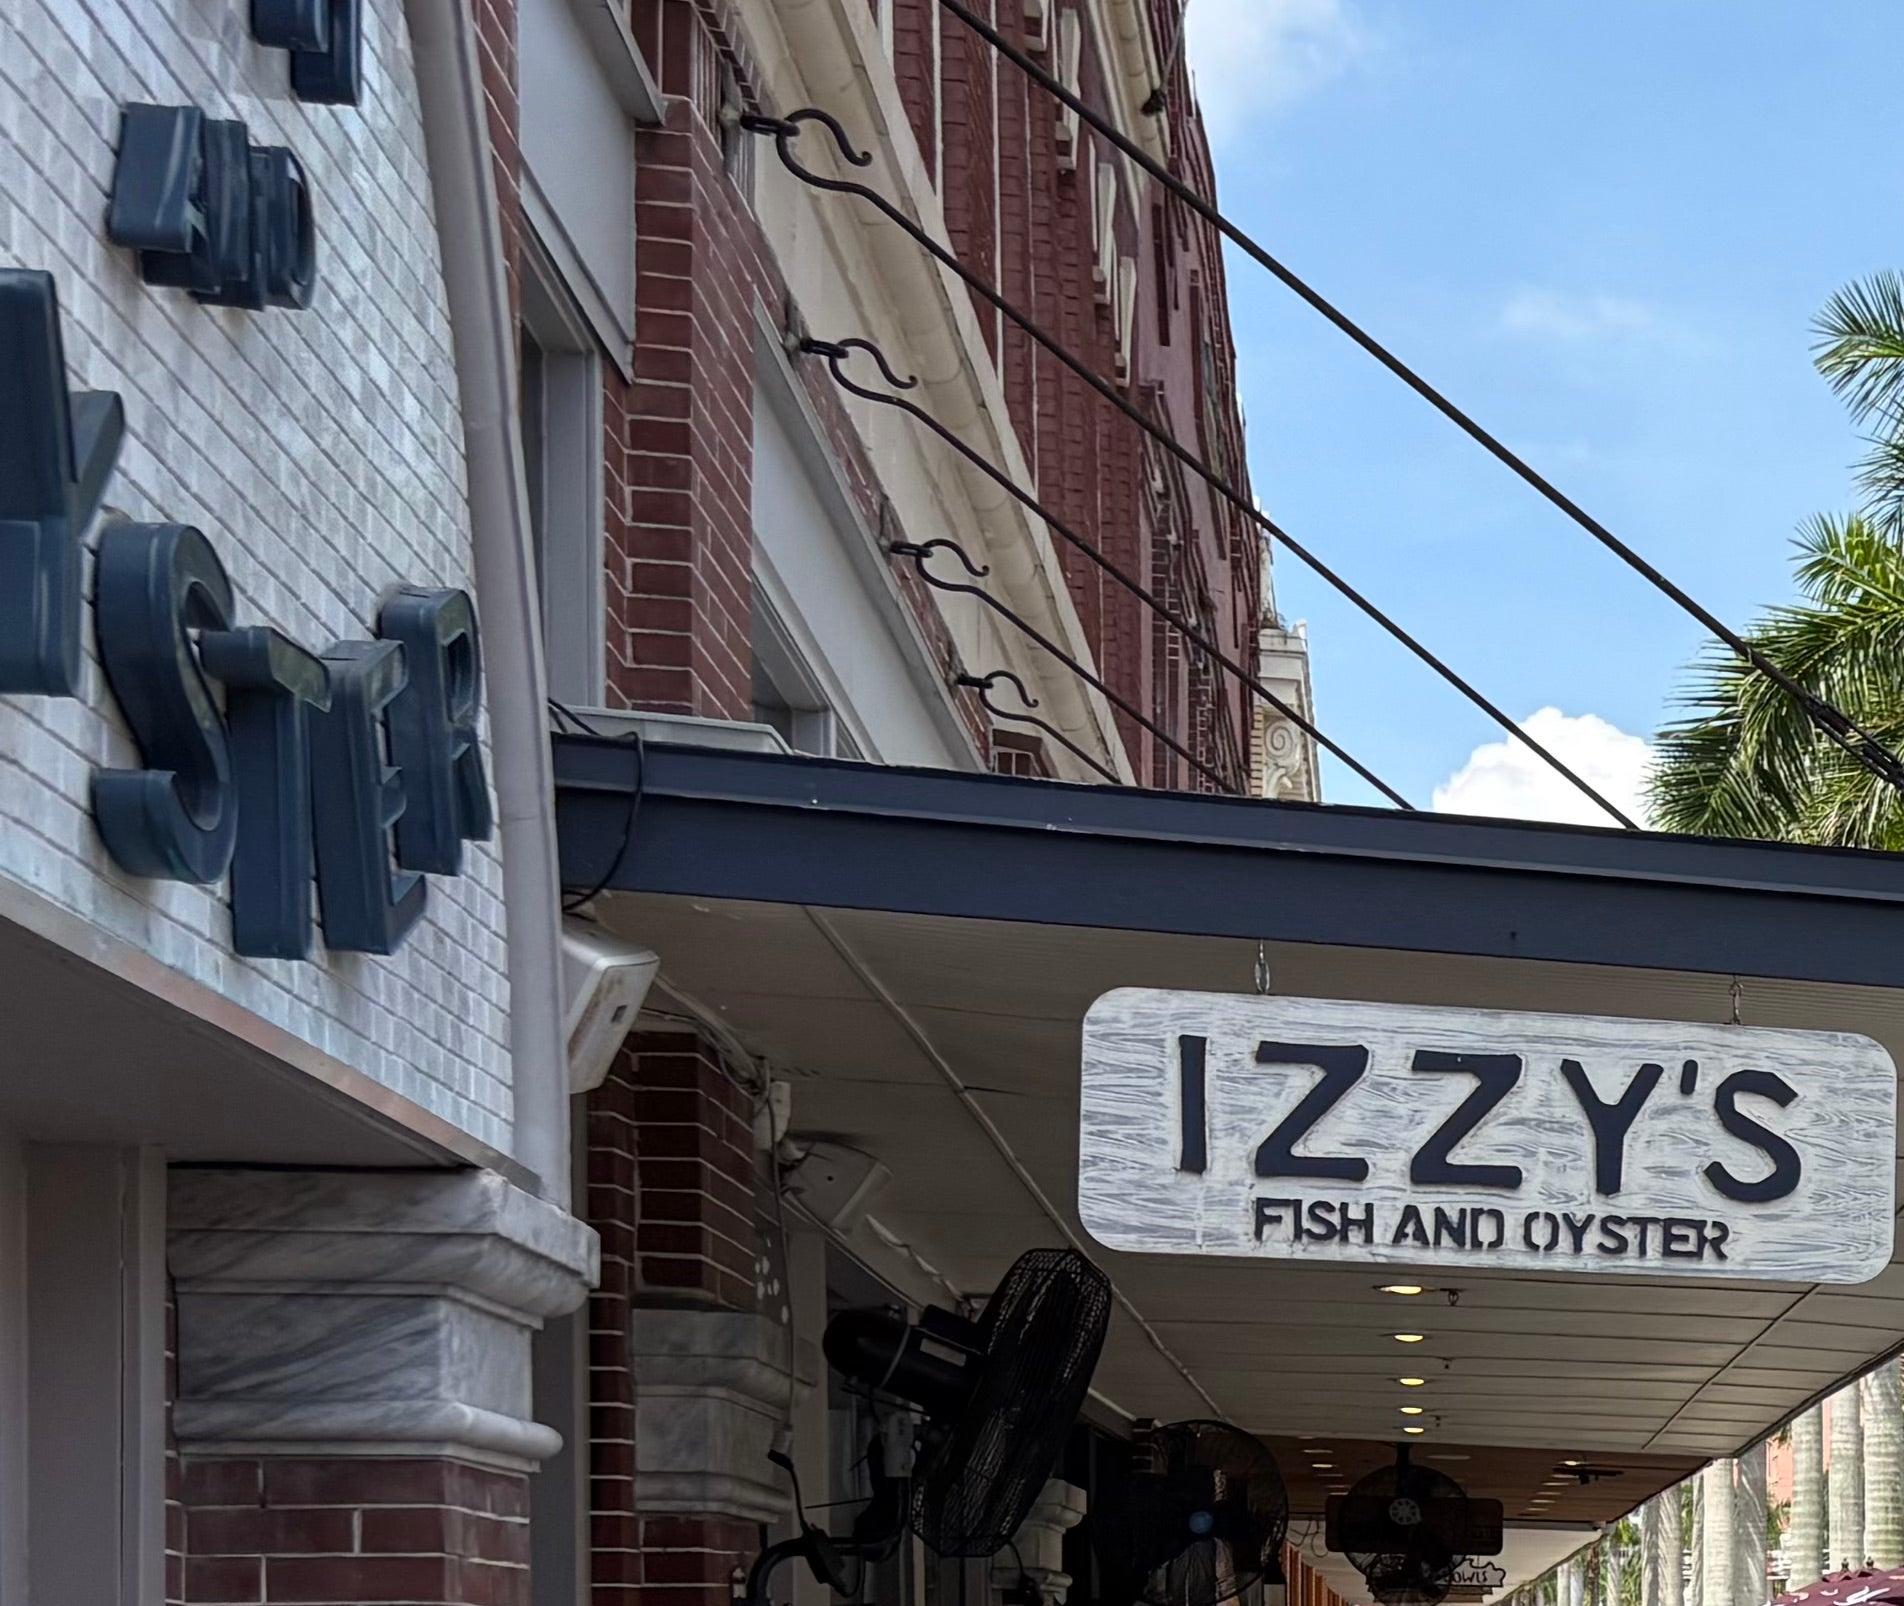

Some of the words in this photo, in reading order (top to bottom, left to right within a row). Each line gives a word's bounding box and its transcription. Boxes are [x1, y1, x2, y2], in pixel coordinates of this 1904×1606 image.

[1178, 1034, 1802, 1201] IZZY'S
[1253, 1197, 1374, 1245] FISH
[1391, 1203, 1503, 1250] AND
[1523, 1209, 1729, 1261] OYSTER
